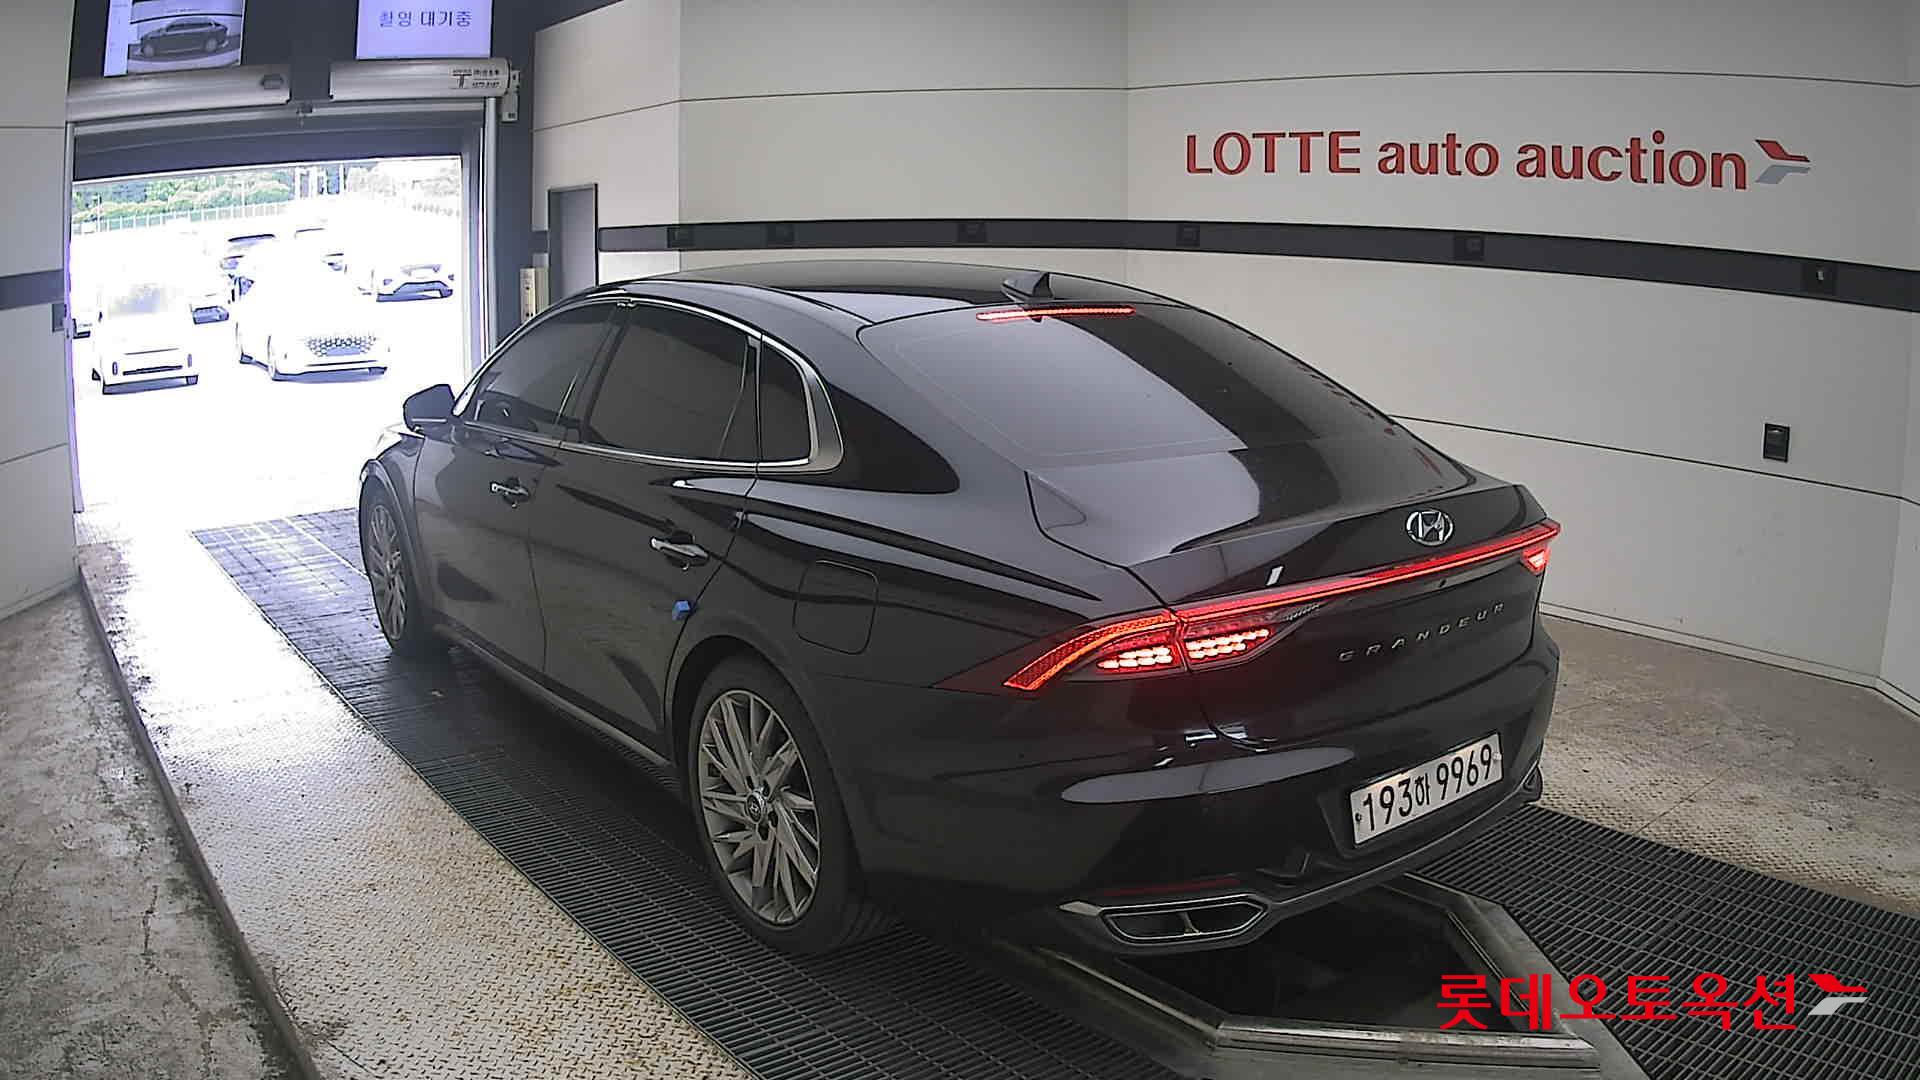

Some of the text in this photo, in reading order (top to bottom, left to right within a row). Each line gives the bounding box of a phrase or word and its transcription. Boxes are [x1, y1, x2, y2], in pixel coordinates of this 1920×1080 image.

[420, 10, 473, 28] 대기중
[1186, 130, 1747, 190] LOTTE auto auction
[1338, 602, 1505, 663] GRANDEUR
[1362, 743, 1493, 832] 193하 9969
